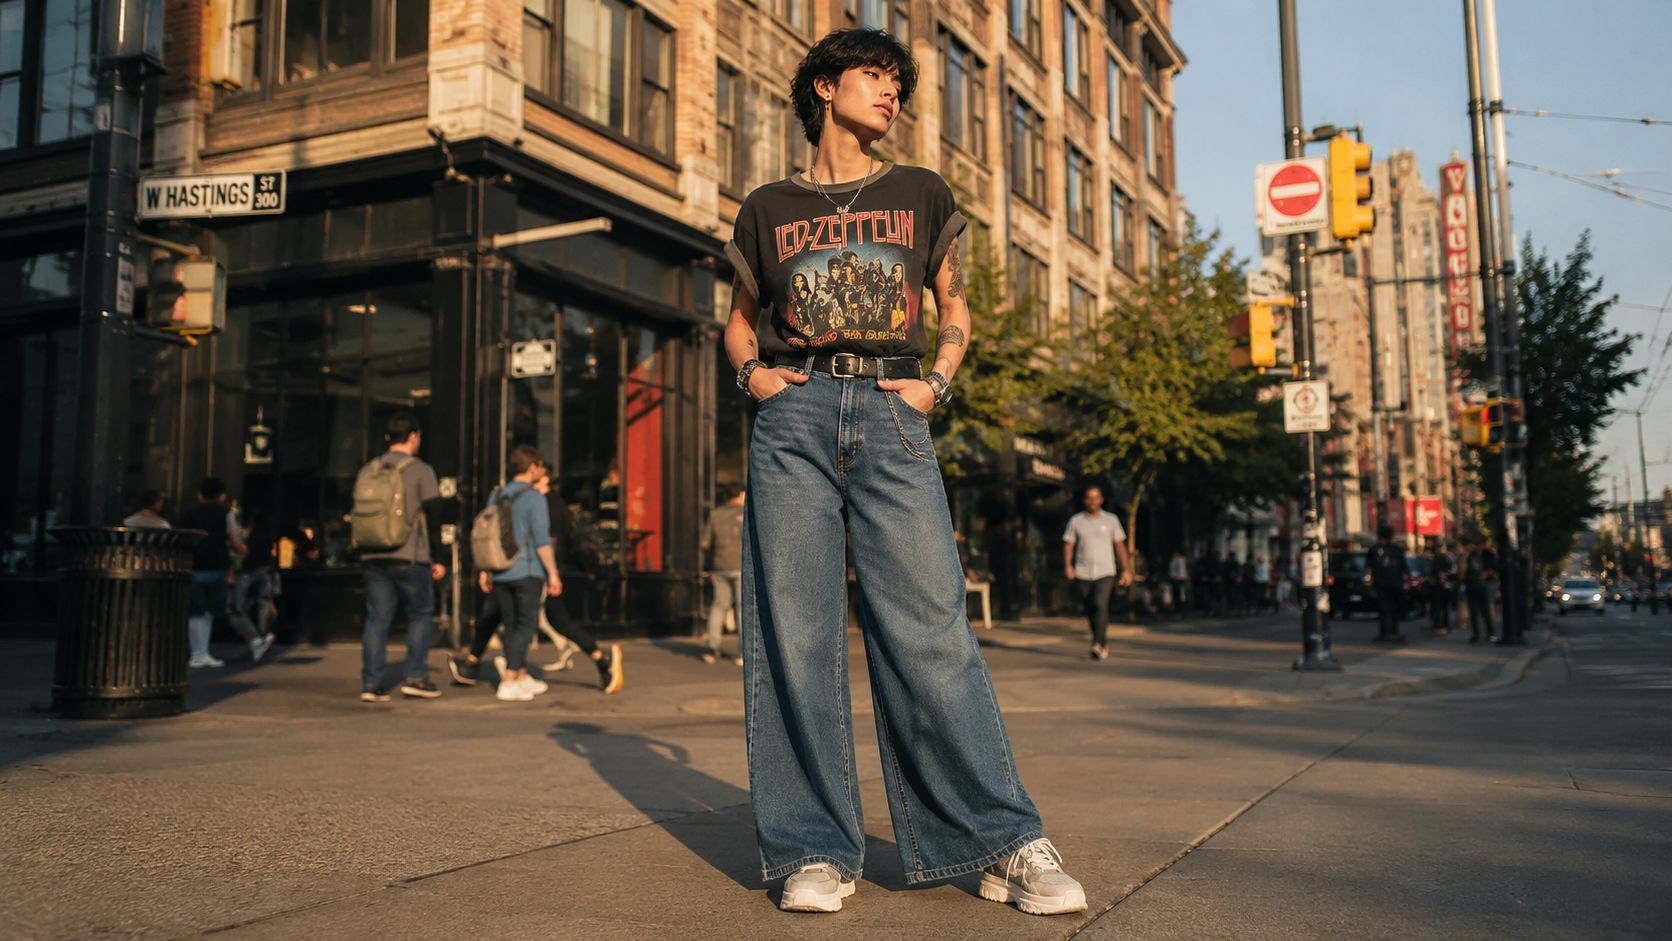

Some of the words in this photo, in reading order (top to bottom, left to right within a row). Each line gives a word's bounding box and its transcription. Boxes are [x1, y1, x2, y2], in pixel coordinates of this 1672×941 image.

[147, 187, 161, 208] W
[166, 183, 249, 207] HASTINGS
[255, 192, 278, 208] 300
